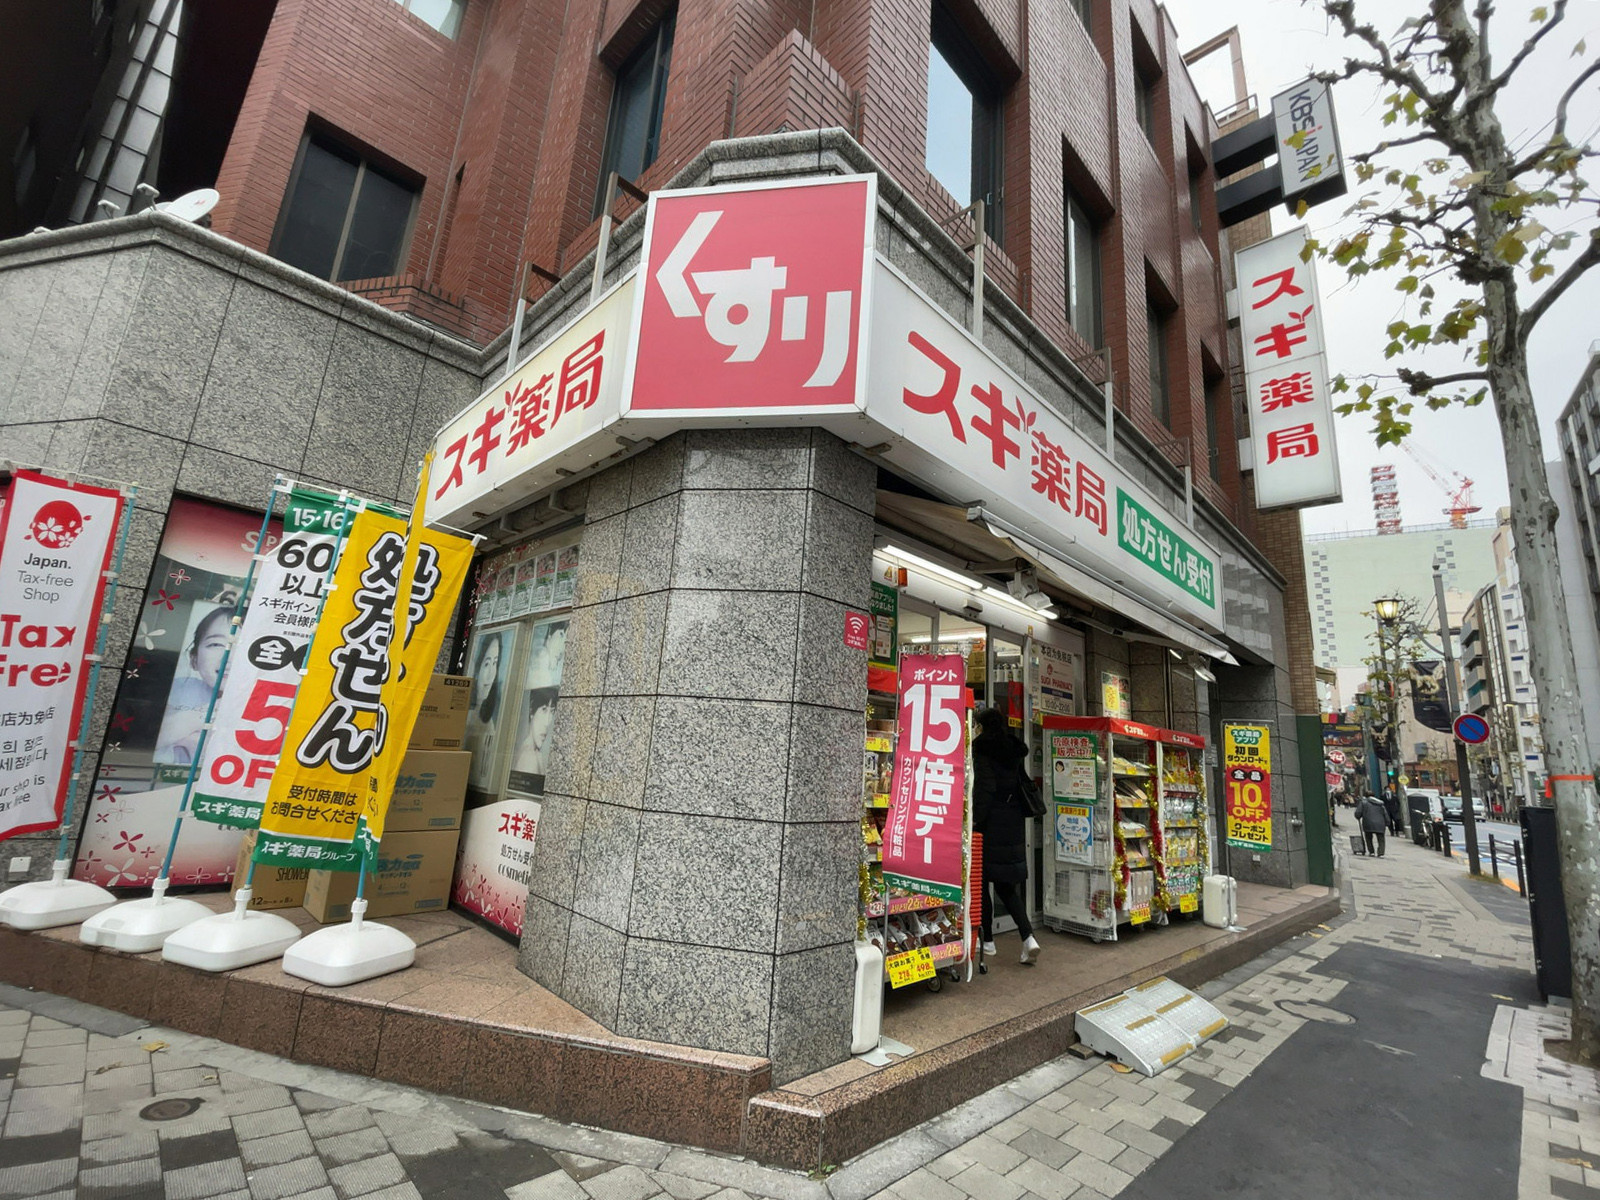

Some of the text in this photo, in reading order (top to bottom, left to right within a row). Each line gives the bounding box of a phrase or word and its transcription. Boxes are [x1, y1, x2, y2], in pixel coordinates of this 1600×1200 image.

[656, 210, 852, 388] くすり
[1252, 266, 1320, 464] スギ薬局
[435, 328, 605, 501] スギ薬局
[903, 330, 1107, 537] スギ薬局
[23, 553, 72, 569] Japan.
[1122, 500, 1211, 600] 処方せん受付
[17, 570, 74, 587] Tax-free
[22, 588, 60, 603] Shop
[0, 614, 77, 648] Tax
[914, 669, 957, 682] ポイント
[904, 684, 961, 756] 15
[1235, 746, 1259, 756] 初回
[34, 775, 45, 785] is
[287, 785, 359, 807] 受付時間は
[892, 757, 912, 857] カウンセリング化粧品
[1232, 807, 1265, 820] OFF
[498, 812, 537, 842] スギ薬
[1231, 830, 1268, 842] プレゼント
[1234, 823, 1266, 834] クーポン
